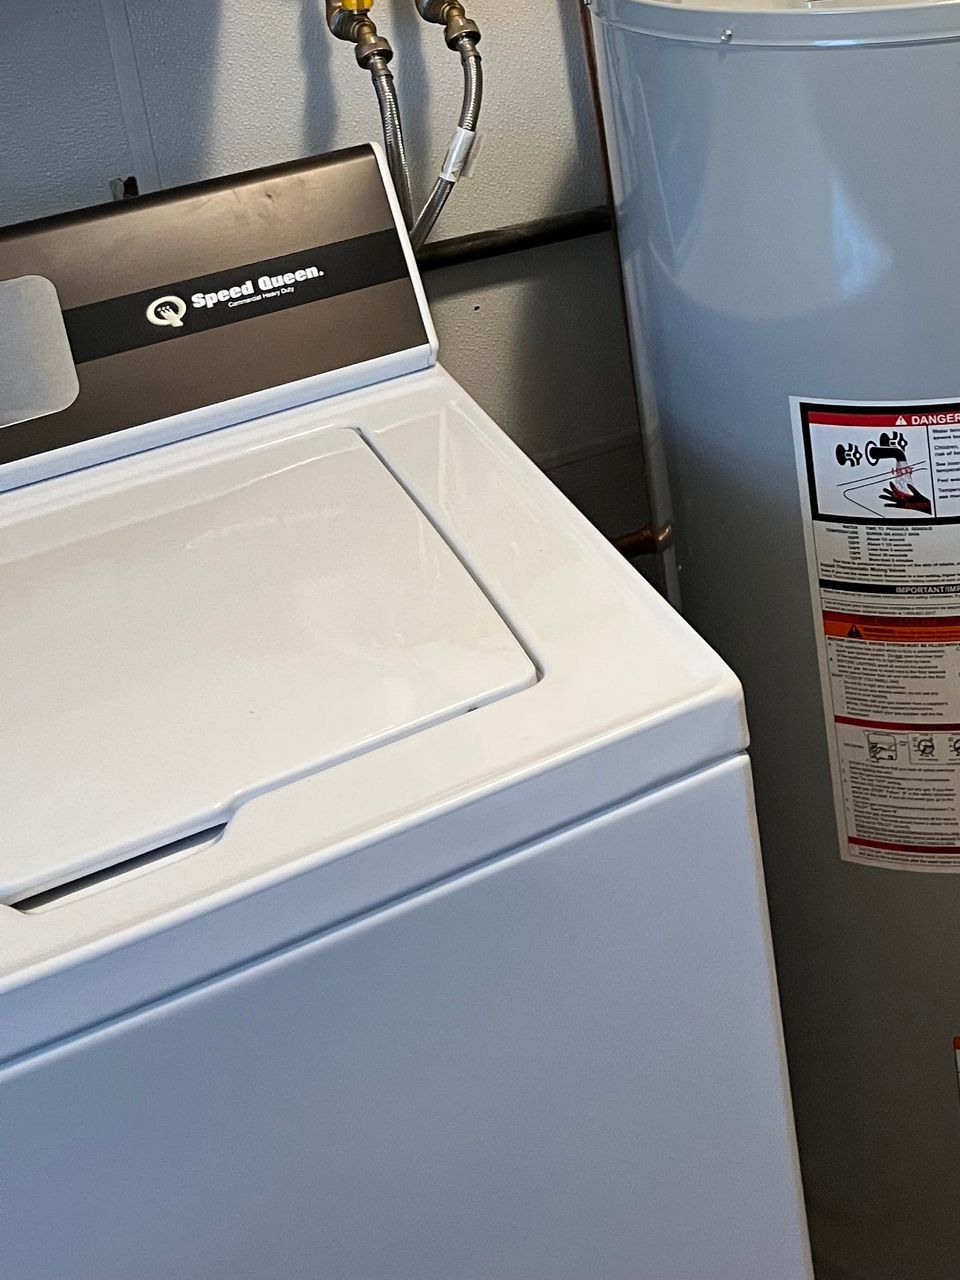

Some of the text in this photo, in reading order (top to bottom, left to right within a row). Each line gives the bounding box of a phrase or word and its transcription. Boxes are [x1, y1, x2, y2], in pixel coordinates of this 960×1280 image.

[191, 280, 254, 308] Speed
[228, 295, 262, 308] Commercial
[263, 290, 280, 299] Heavy
